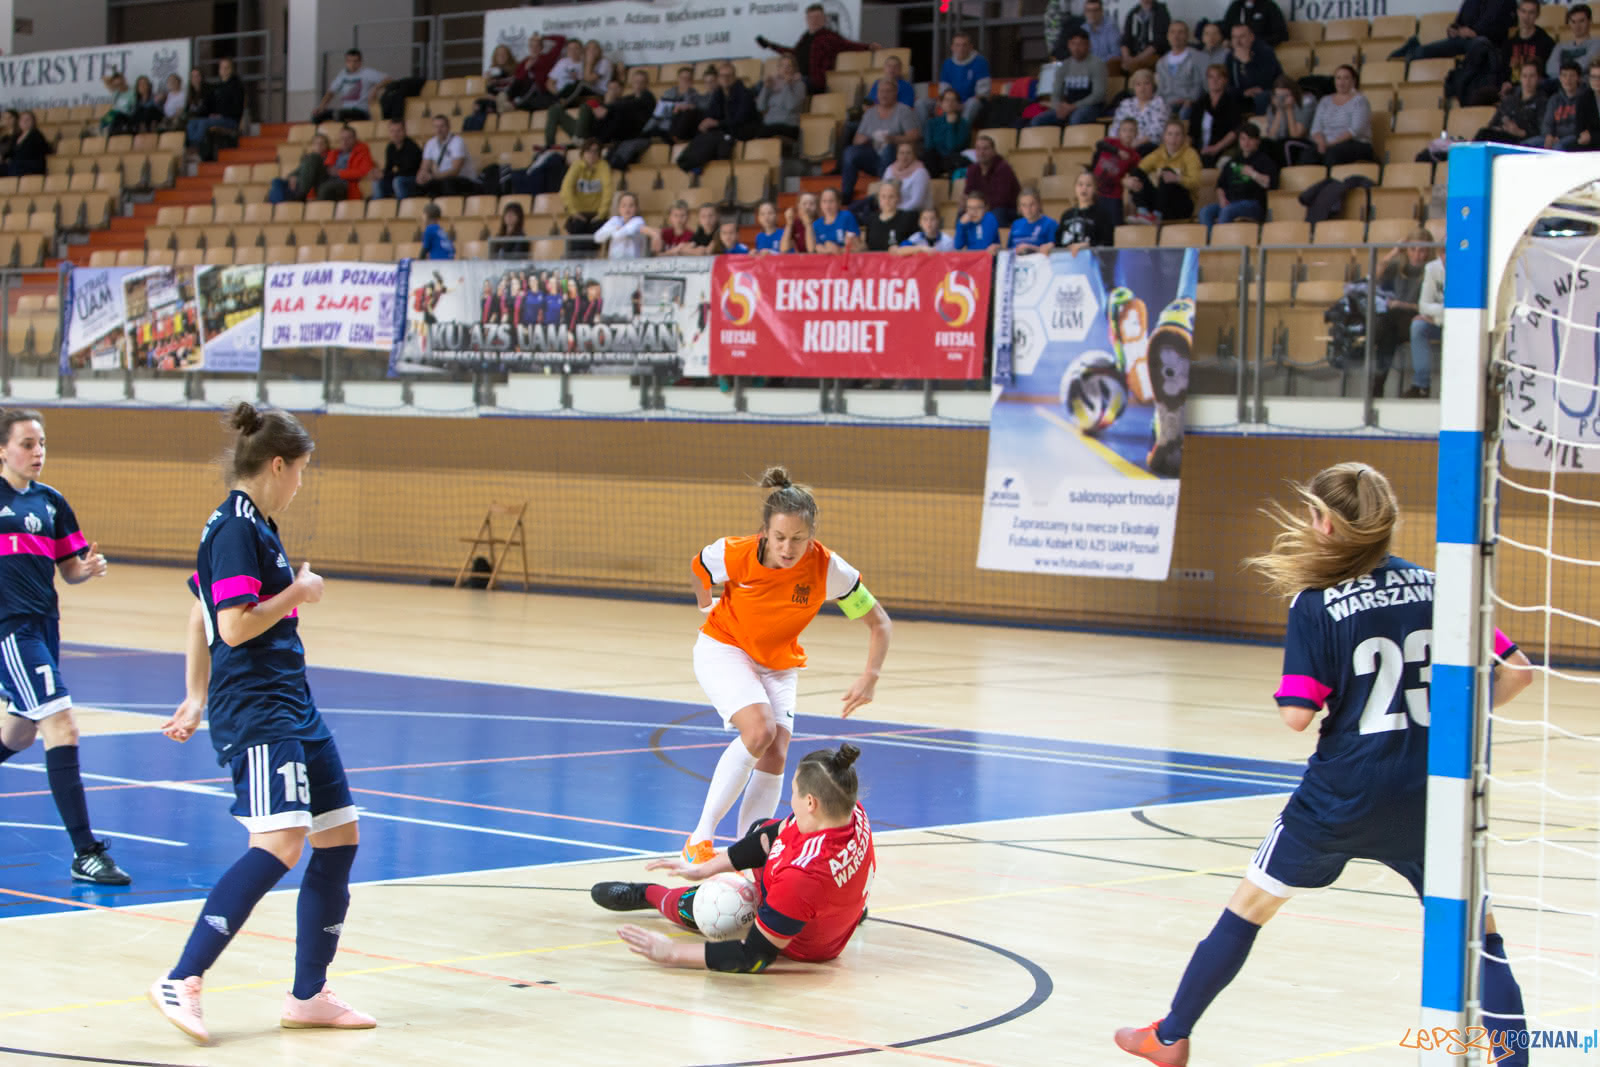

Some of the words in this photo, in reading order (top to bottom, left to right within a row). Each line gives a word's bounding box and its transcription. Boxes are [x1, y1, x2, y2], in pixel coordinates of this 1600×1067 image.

[732, 7, 741, 15] w
[681, 34, 700, 47] AZS
[704, 31, 731, 44] UAM
[271, 272, 295, 288] AZS
[302, 269, 333, 286] UAM
[775, 278, 920, 311] EKSTRALIGA
[272, 297, 305, 313] ALA
[432, 322, 463, 351] KU
[470, 322, 512, 351] AZS
[517, 322, 569, 351] UAM
[721, 330, 757, 344] FUTSAL
[803, 320, 888, 353] KOBIET
[935, 331, 975, 347] FUTSAL
[1068, 489, 1175, 507] salonsportmoda.pl
[1012, 516, 1069, 534] Zapraszamy
[1072, 522, 1083, 532] na
[1086, 522, 1118, 533] mecze
[1046, 538, 1073, 549] Kobiet
[1075, 539, 1088, 550] KU
[1090, 540, 1106, 551] AZS
[1108, 541, 1128, 552] UAM
[1324, 574, 1376, 605] AZS
[1326, 585, 1433, 622] WARSZAW
[1353, 628, 1432, 735] 23
[276, 761, 312, 804] 15
